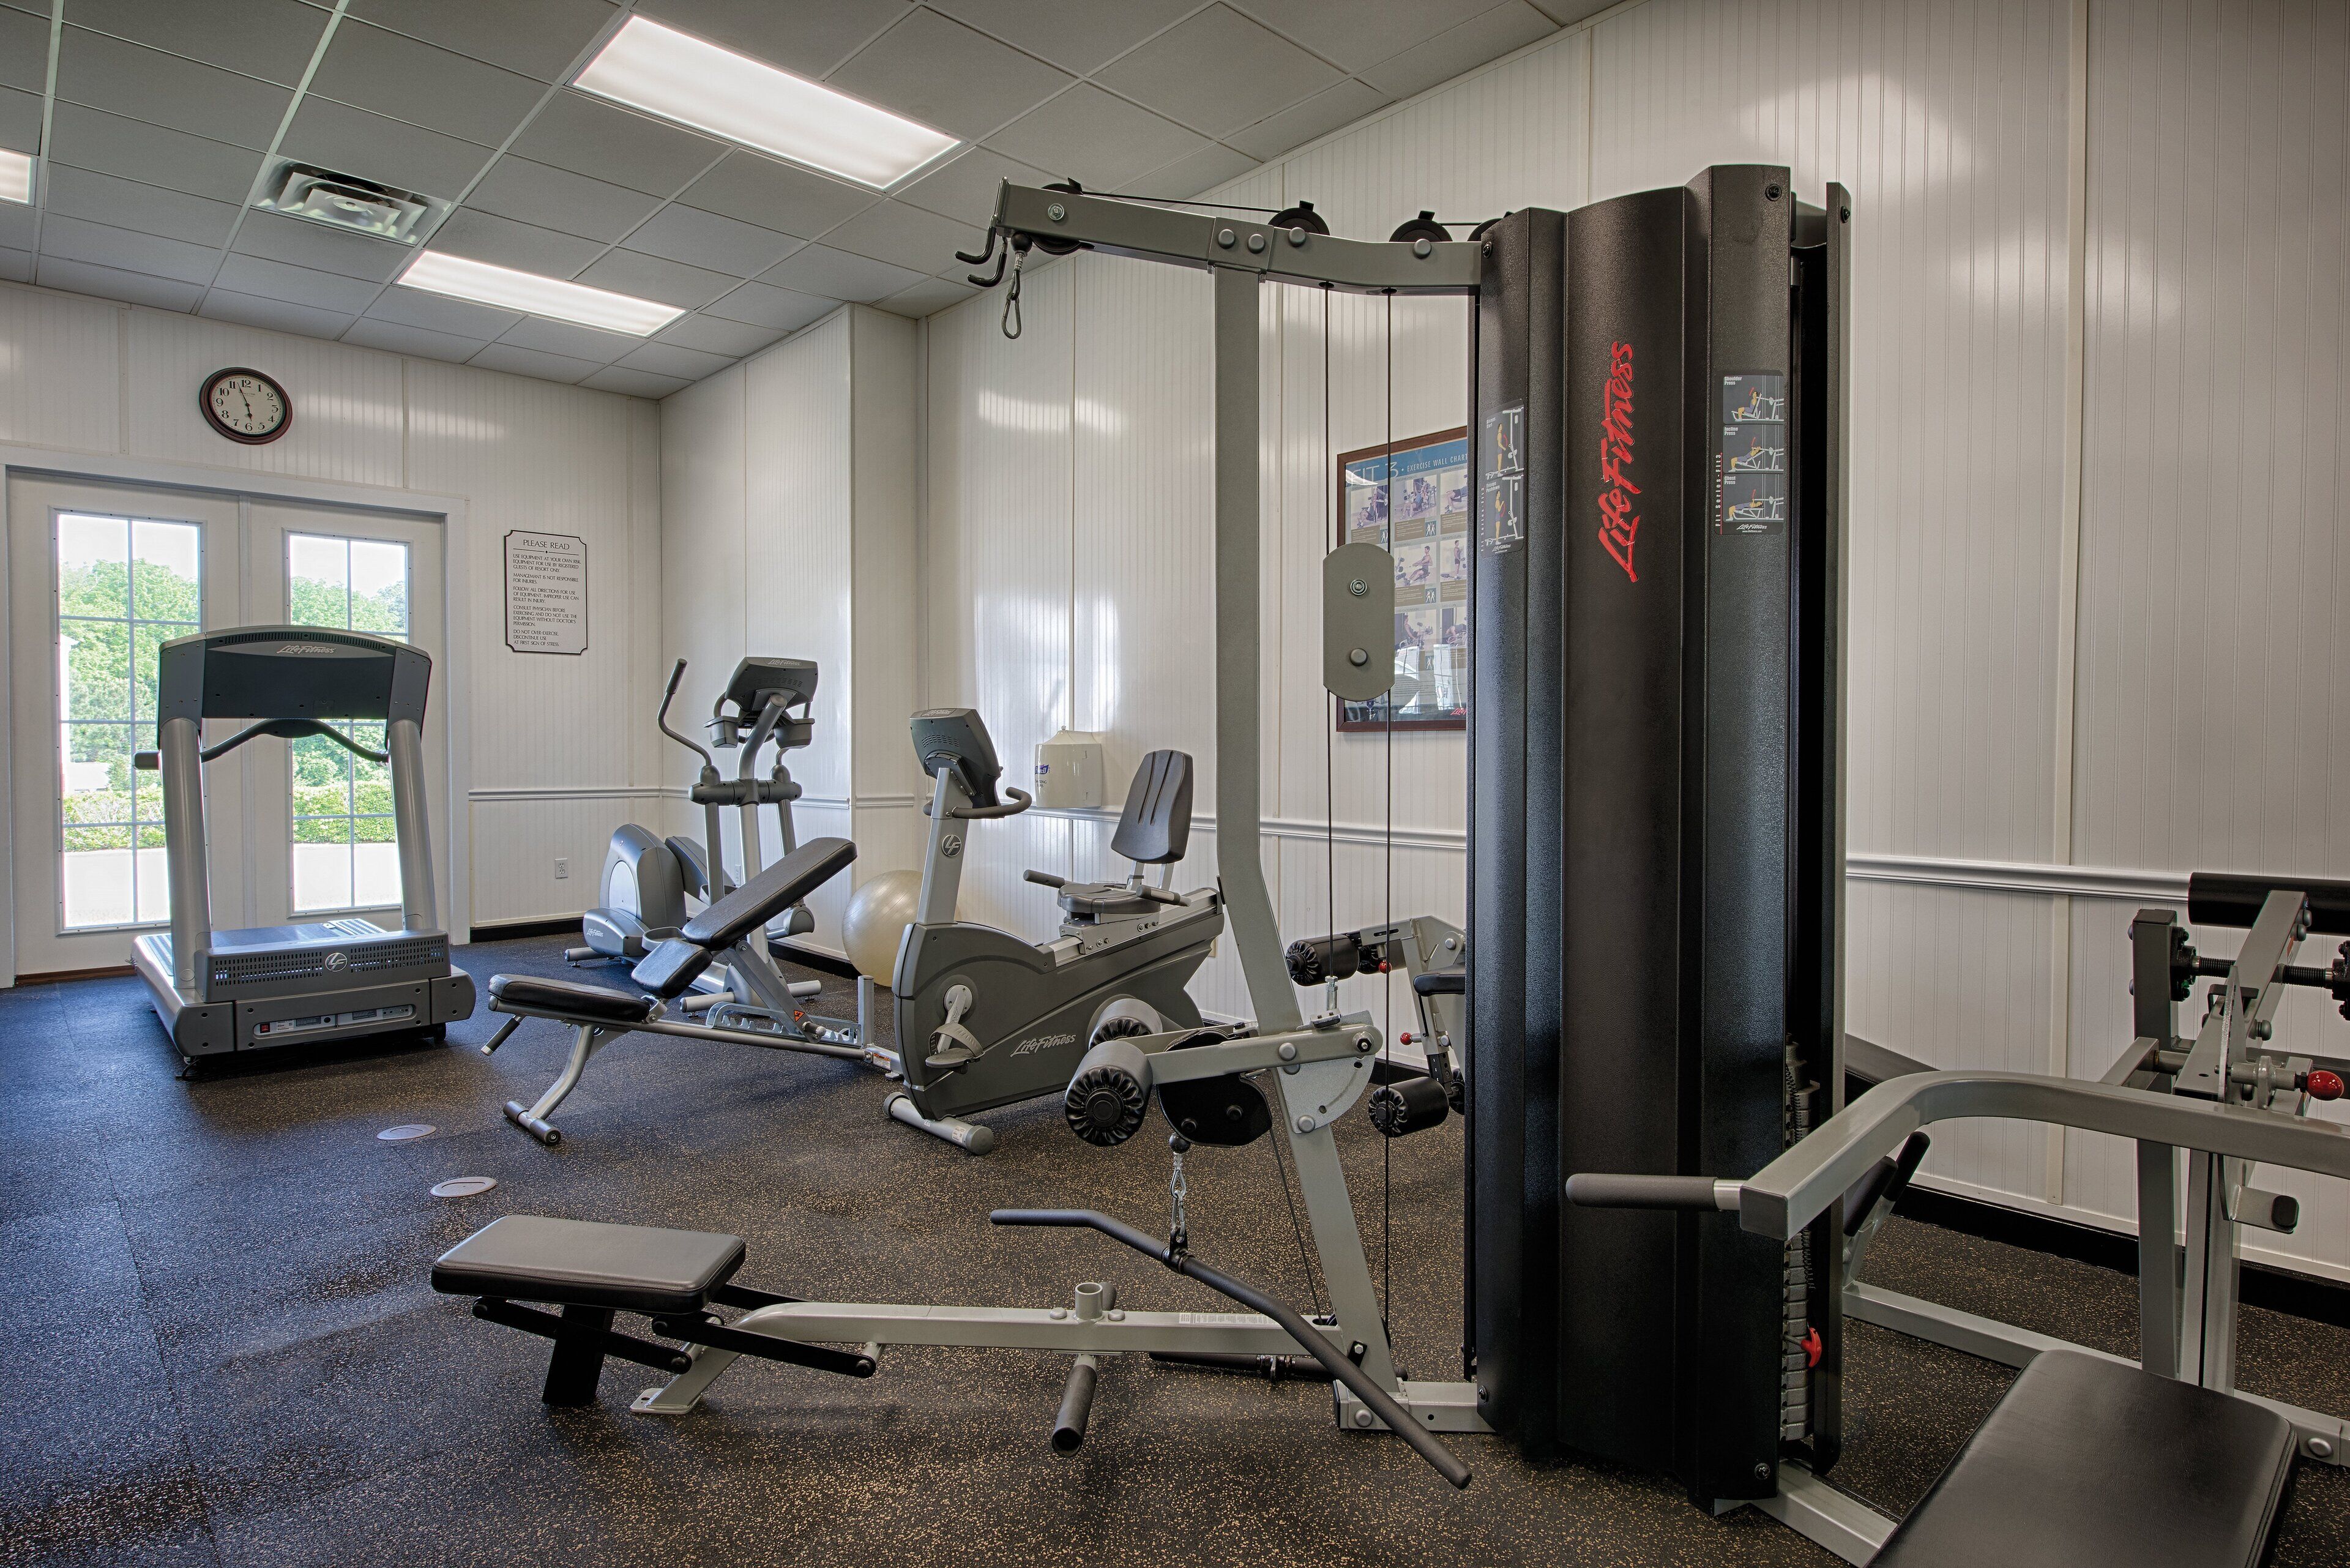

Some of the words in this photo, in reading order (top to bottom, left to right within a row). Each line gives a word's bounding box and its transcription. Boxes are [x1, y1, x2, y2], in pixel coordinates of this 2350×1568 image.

[229, 381, 236, 389] 11
[220, 388, 229, 397] 10
[267, 392, 274, 401] 2
[216, 398, 223, 406] 9
[222, 410, 229, 419] 8
[1407, 460, 1431, 472] EXERCISE
[1433, 457, 1447, 467] WALL
[1450, 454, 1468, 463] CHART
